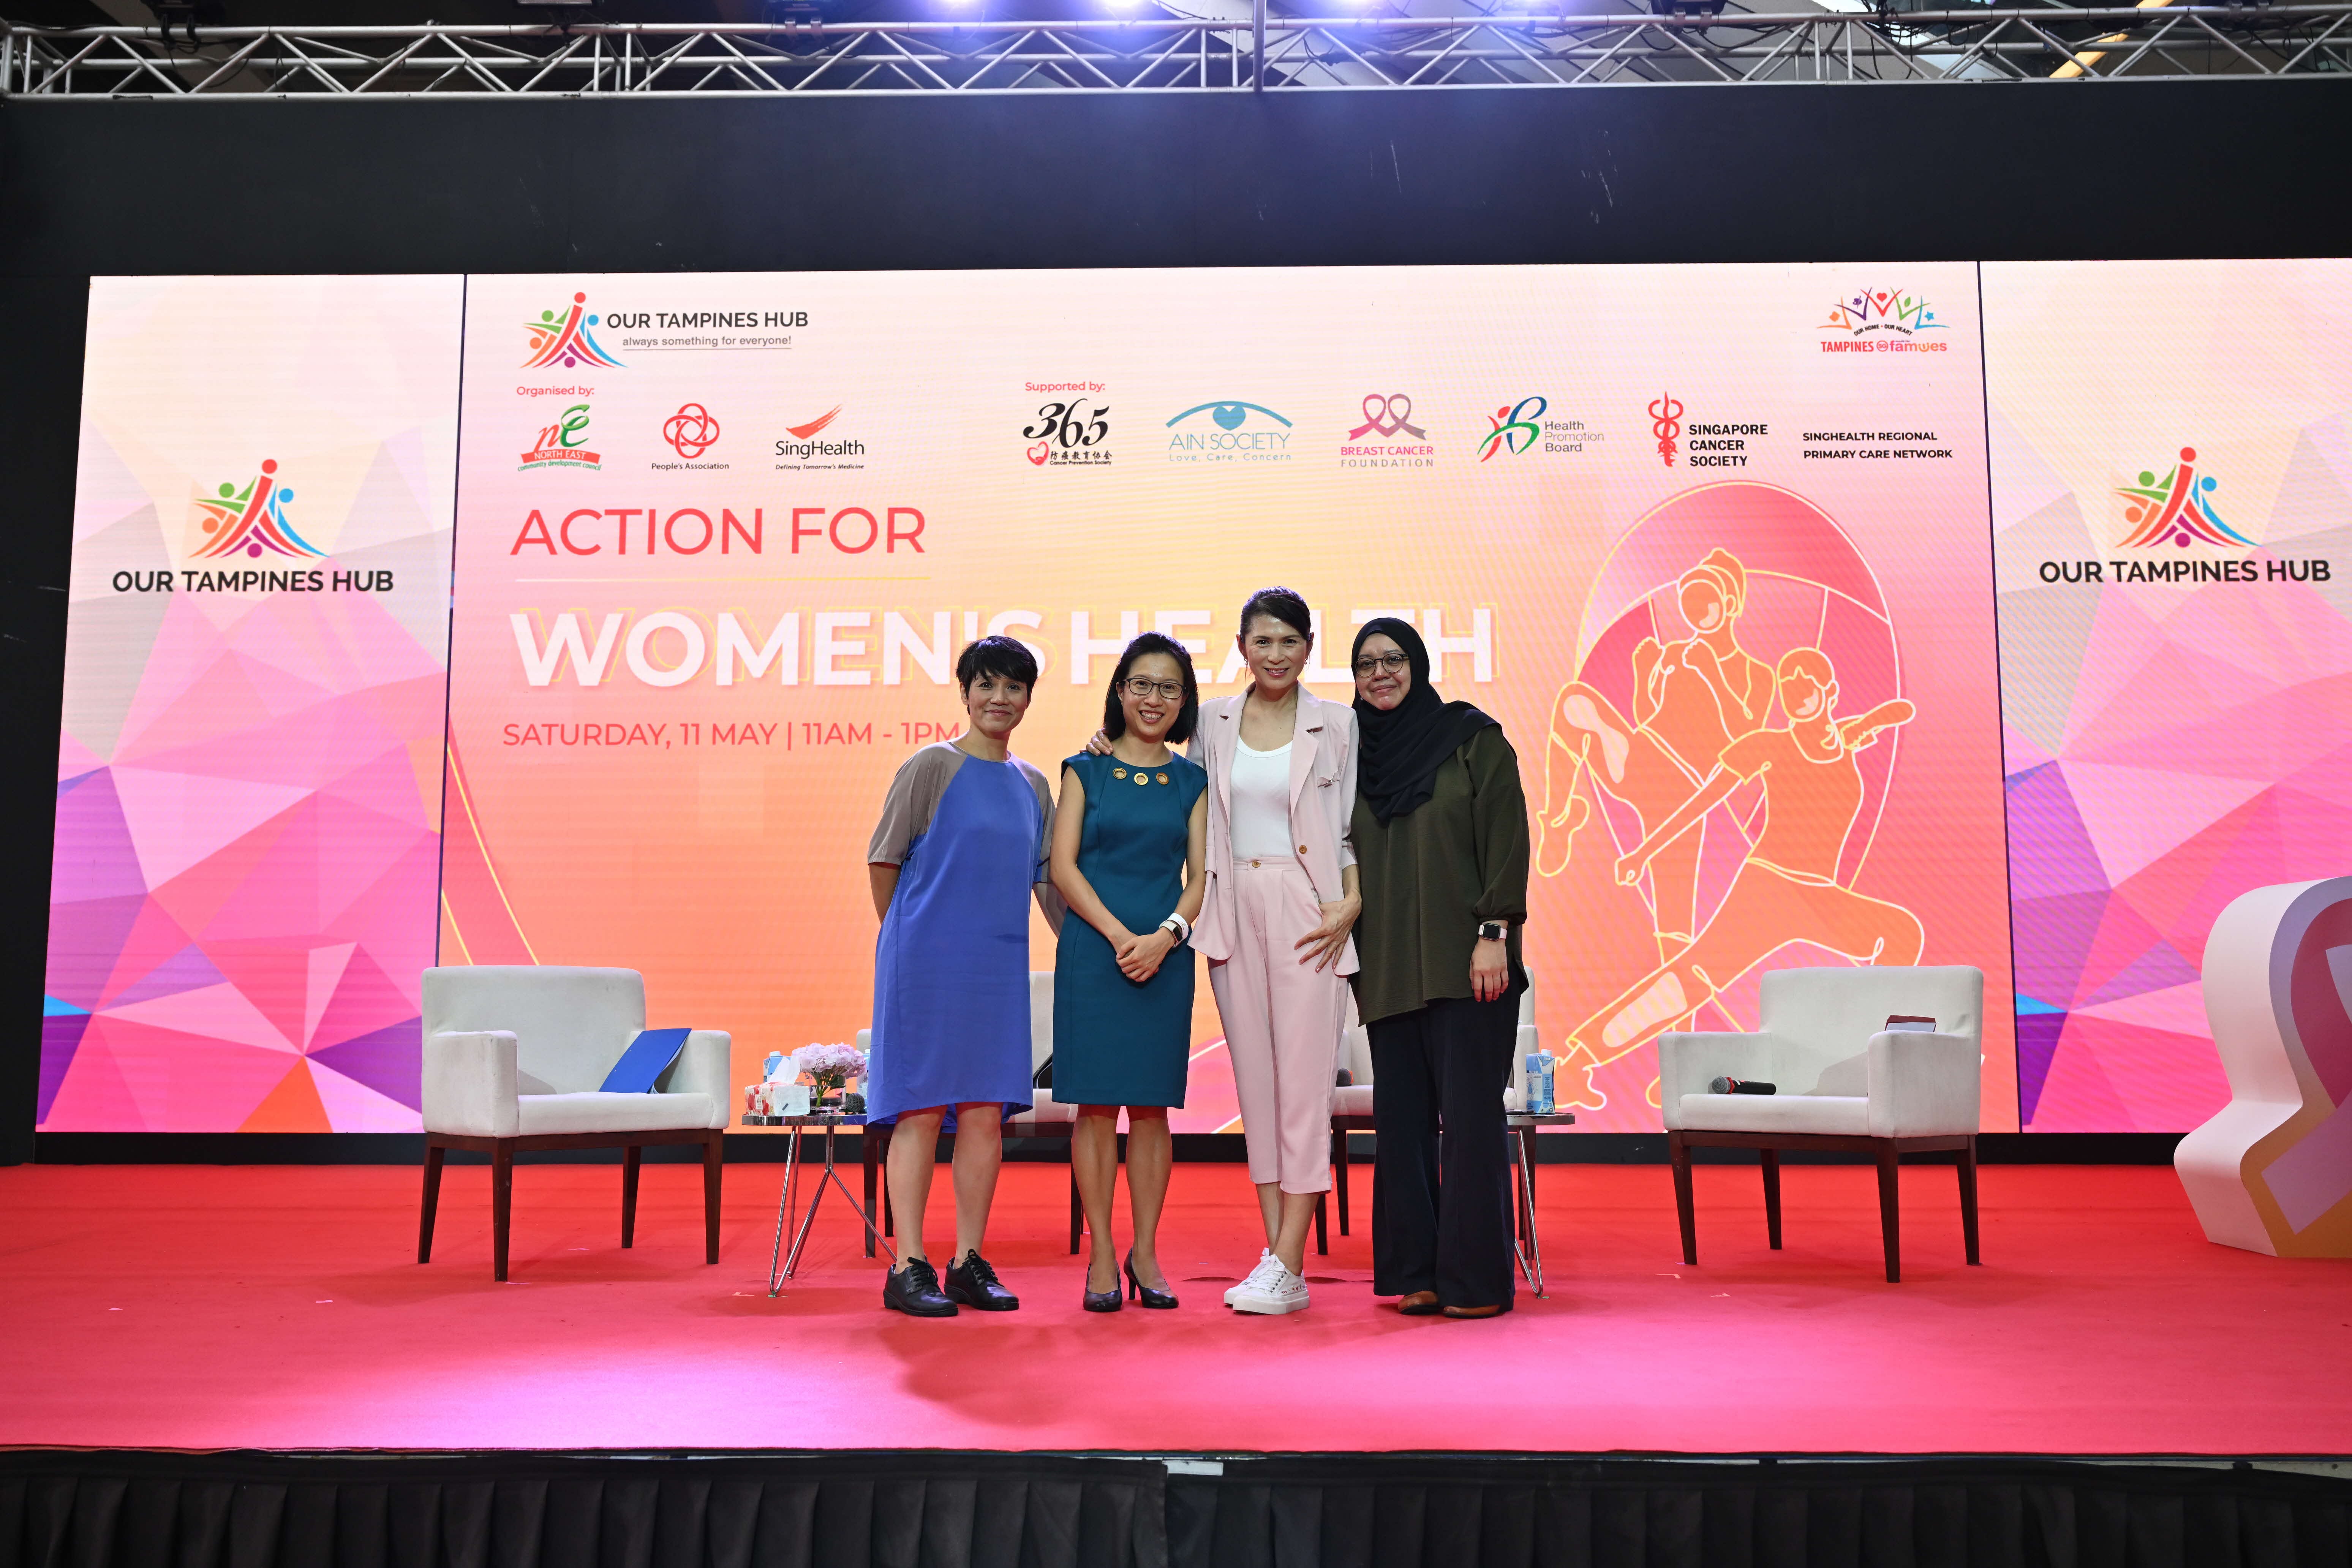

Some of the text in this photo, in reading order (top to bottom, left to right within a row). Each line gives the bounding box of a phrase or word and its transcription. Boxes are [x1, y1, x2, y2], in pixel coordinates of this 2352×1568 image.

[607, 312, 808, 329] OUR TAMPINES HUB
[1854, 328, 1864, 337] OUR
[1895, 325, 1913, 337] HEART
[623, 335, 791, 348] always something for everyone!
[1821, 341, 1874, 352] TAMPINES
[516, 386, 594, 397] Organised by:
[1025, 381, 1105, 393] Supported by:
[1023, 398, 1110, 448] 365
[1545, 421, 1584, 430] Health
[1689, 424, 1768, 435] SINGAPORE
[1169, 433, 1290, 450] AIN SOCIETY
[1545, 432, 1604, 441] Promotion
[1803, 432, 1938, 441] SINGHEALTH REGIONAL
[776, 440, 864, 460] SingHealth
[1341, 446, 1434, 455] BREAST CANCER
[1545, 443, 1582, 452] Board
[1690, 440, 1744, 451] CANCER
[534, 450, 587, 460] NORTH EAST
[1169, 453, 1291, 462] Love, Care, Concern
[1804, 449, 1952, 458] PRIMARY CARE NETWORK
[518, 462, 547, 471] community
[651, 462, 683, 471] People's
[1341, 458, 1433, 468] FOUNDATION
[1690, 456, 1748, 467] SOCIETY
[510, 507, 925, 556] ACTION FOR
[2039, 560, 2331, 583] OUR TAMPINES HUB
[113, 571, 394, 592] OUR TAMPINES HUB
[503, 723, 671, 750] SATURDAY,
[680, 723, 700, 745] 11
[712, 723, 778, 745] MAY
[802, 722, 871, 745] 11AM
[901, 722, 959, 744] 1PM
